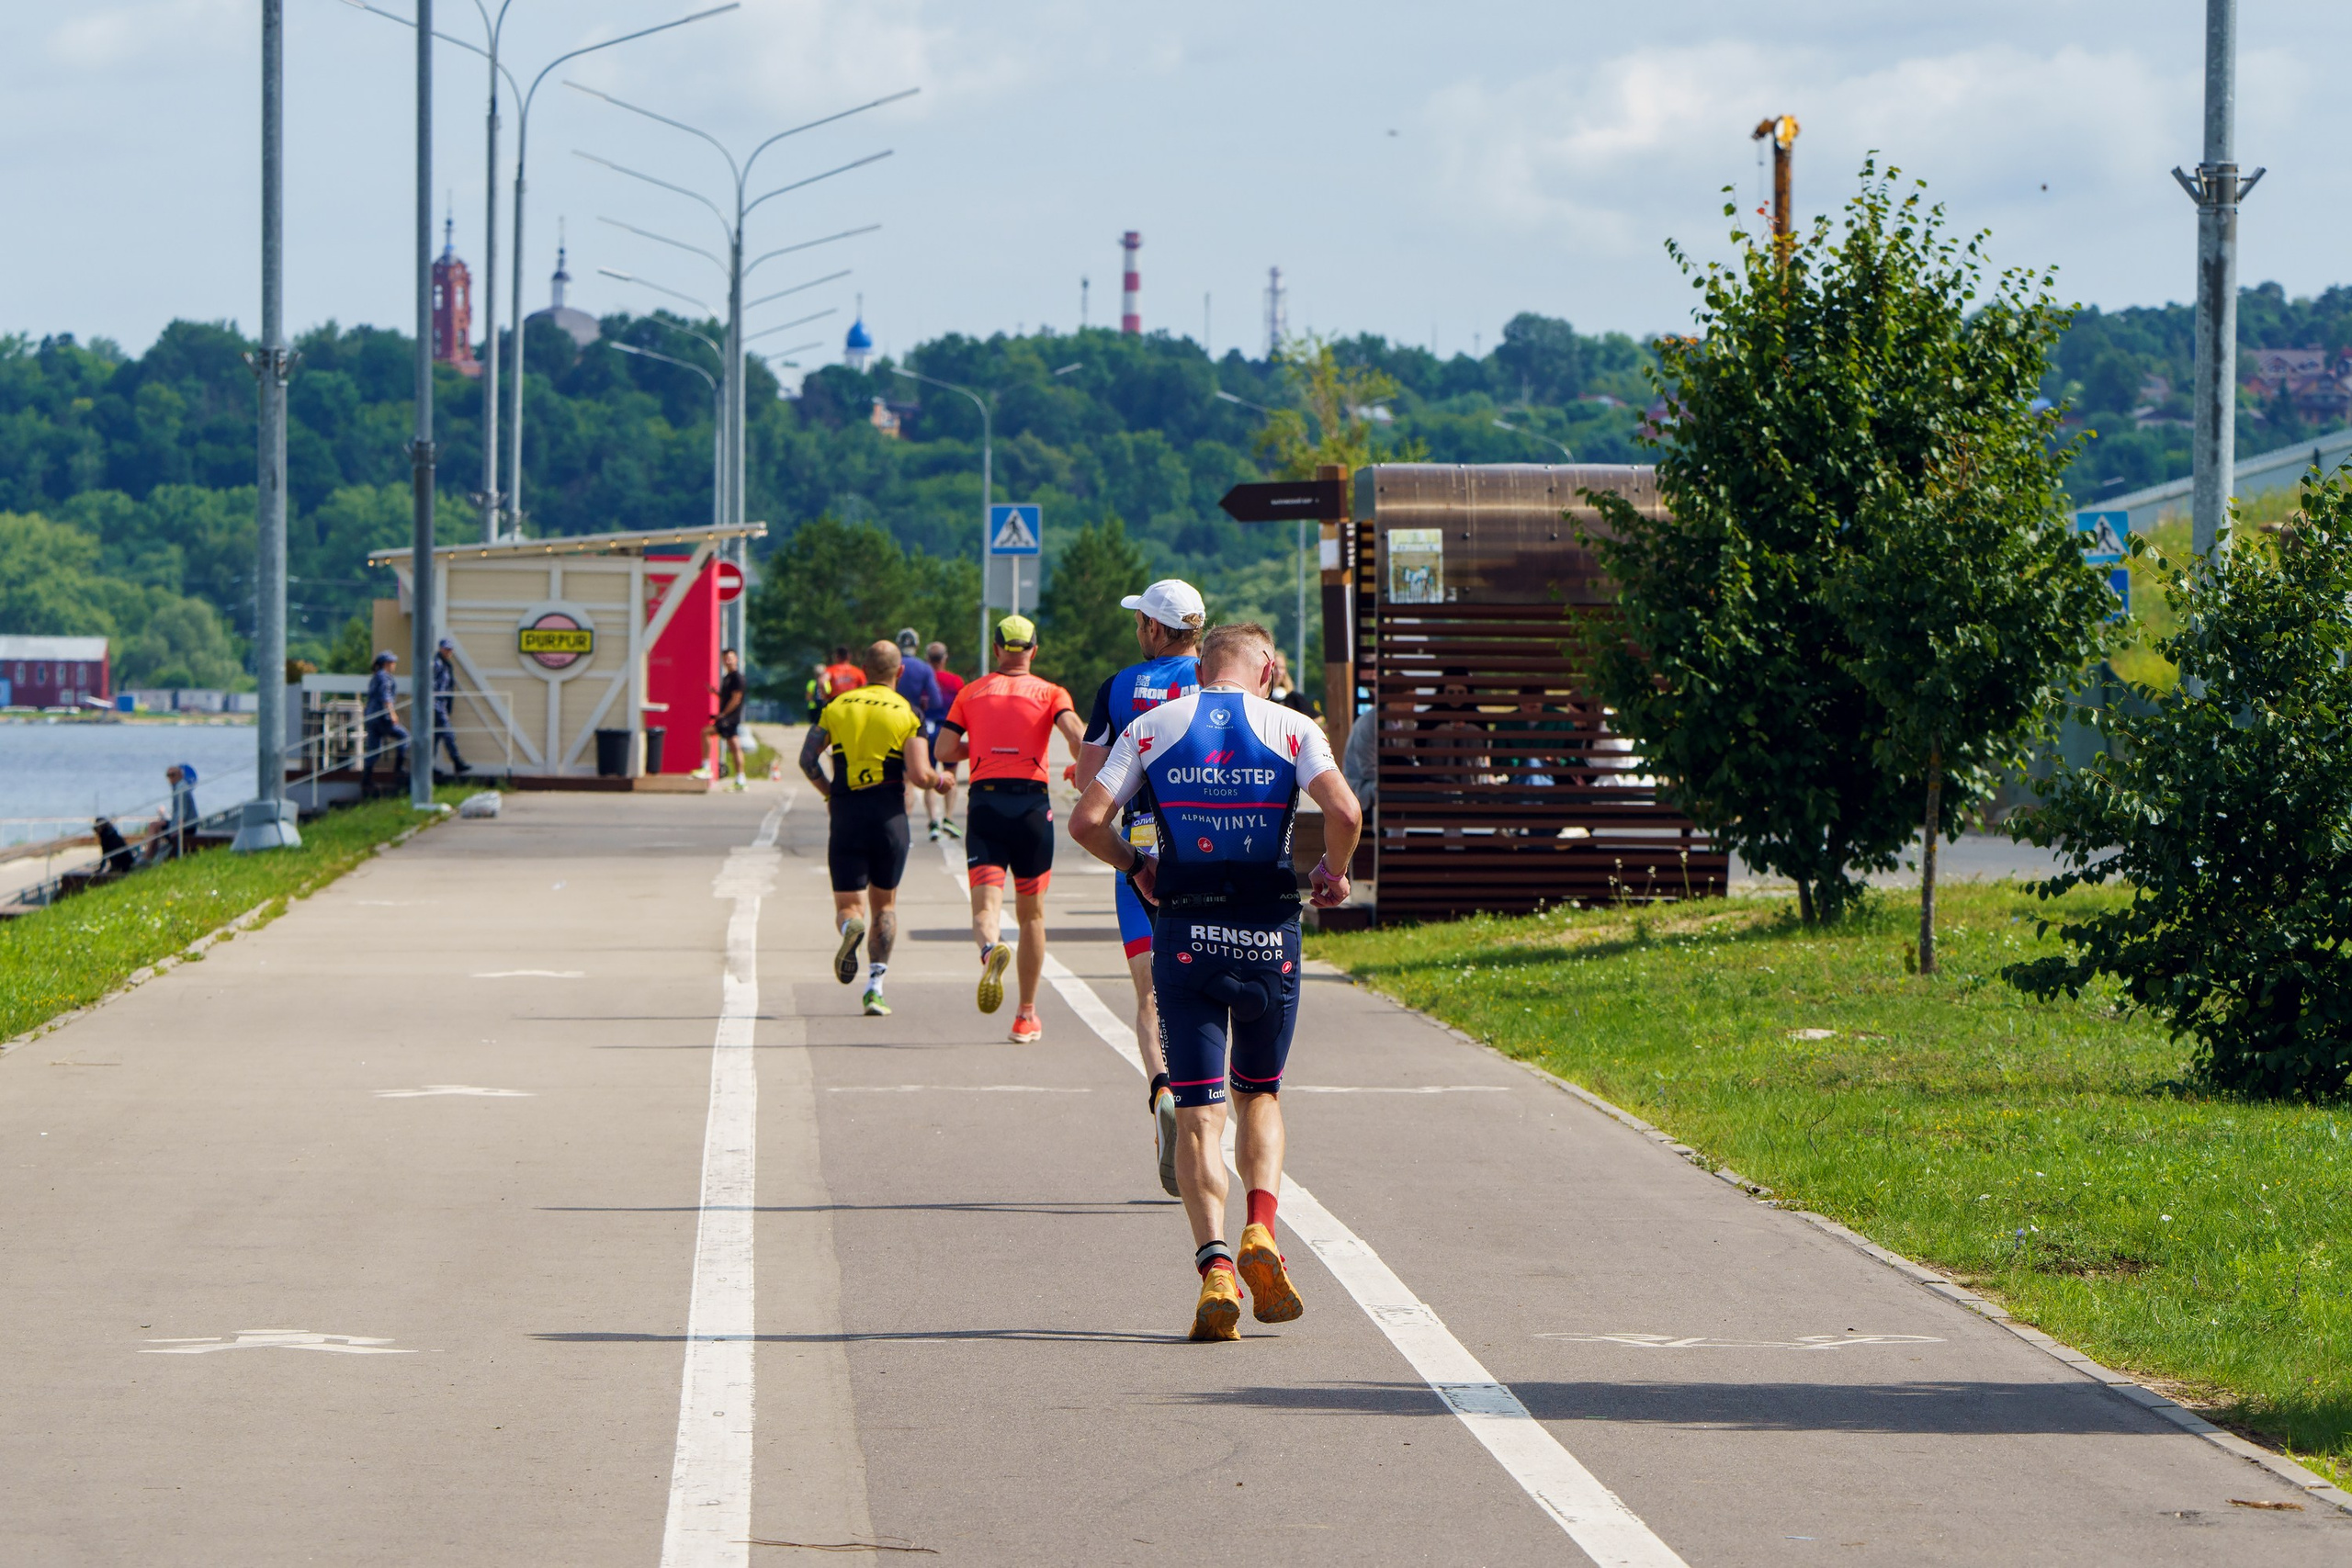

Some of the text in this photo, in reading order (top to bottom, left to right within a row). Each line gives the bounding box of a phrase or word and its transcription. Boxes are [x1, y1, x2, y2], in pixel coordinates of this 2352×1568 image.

[526, 634, 588, 649] PURPUR
[1133, 682, 1200, 699] IRONMAN
[842, 698, 903, 709] SCOTT
[1204, 788, 1238, 796] FLOORS
[1182, 814, 1267, 831] ALPHA VINYL
[1191, 925, 1283, 947] RENSON
[1191, 942, 1283, 961] OUTDOOR
[1161, 1018, 1170, 1048] FLOORS
